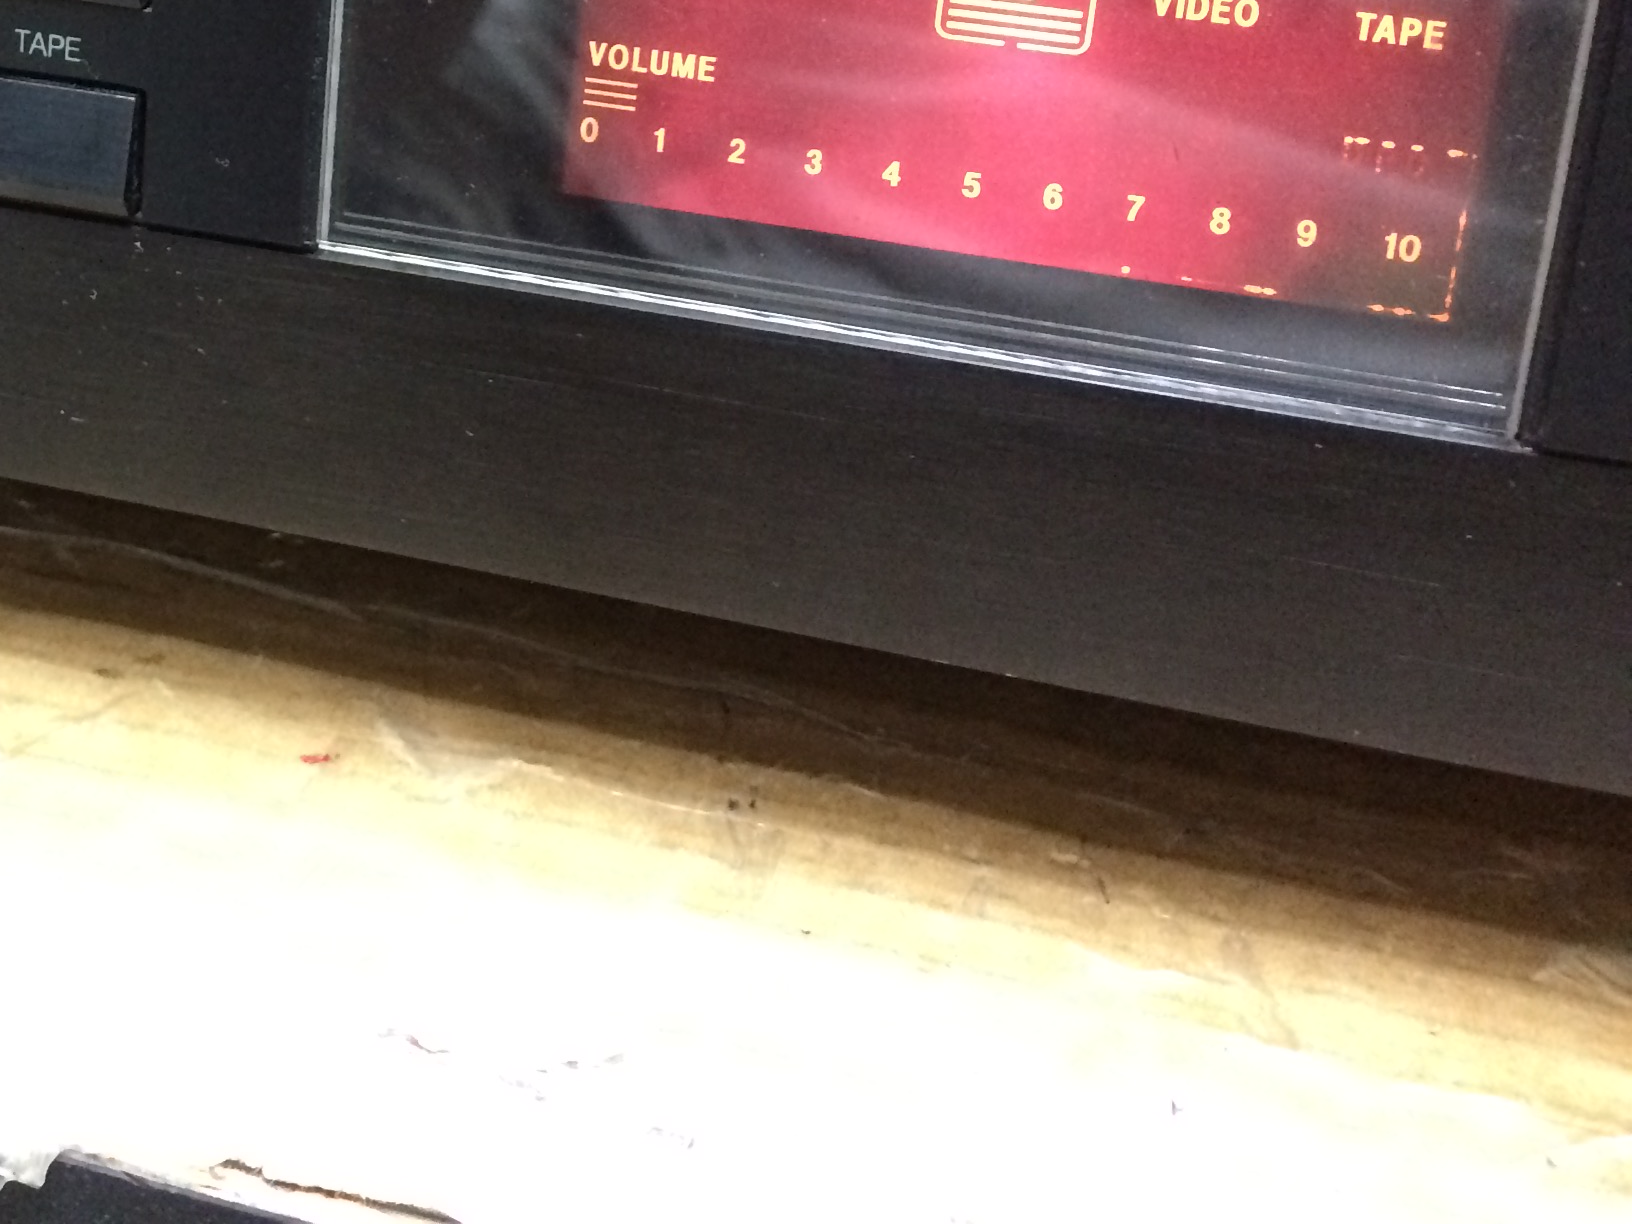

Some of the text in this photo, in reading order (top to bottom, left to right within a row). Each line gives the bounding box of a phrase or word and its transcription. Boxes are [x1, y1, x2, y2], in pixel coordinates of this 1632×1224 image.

[14, 28, 82, 62] TAPE
[1354, 11, 1448, 52] TAPE
[587, 41, 718, 83] VOLUME
[579, 117, 1422, 263] 0 1 2 3 4 5 6 7 8 9 10
